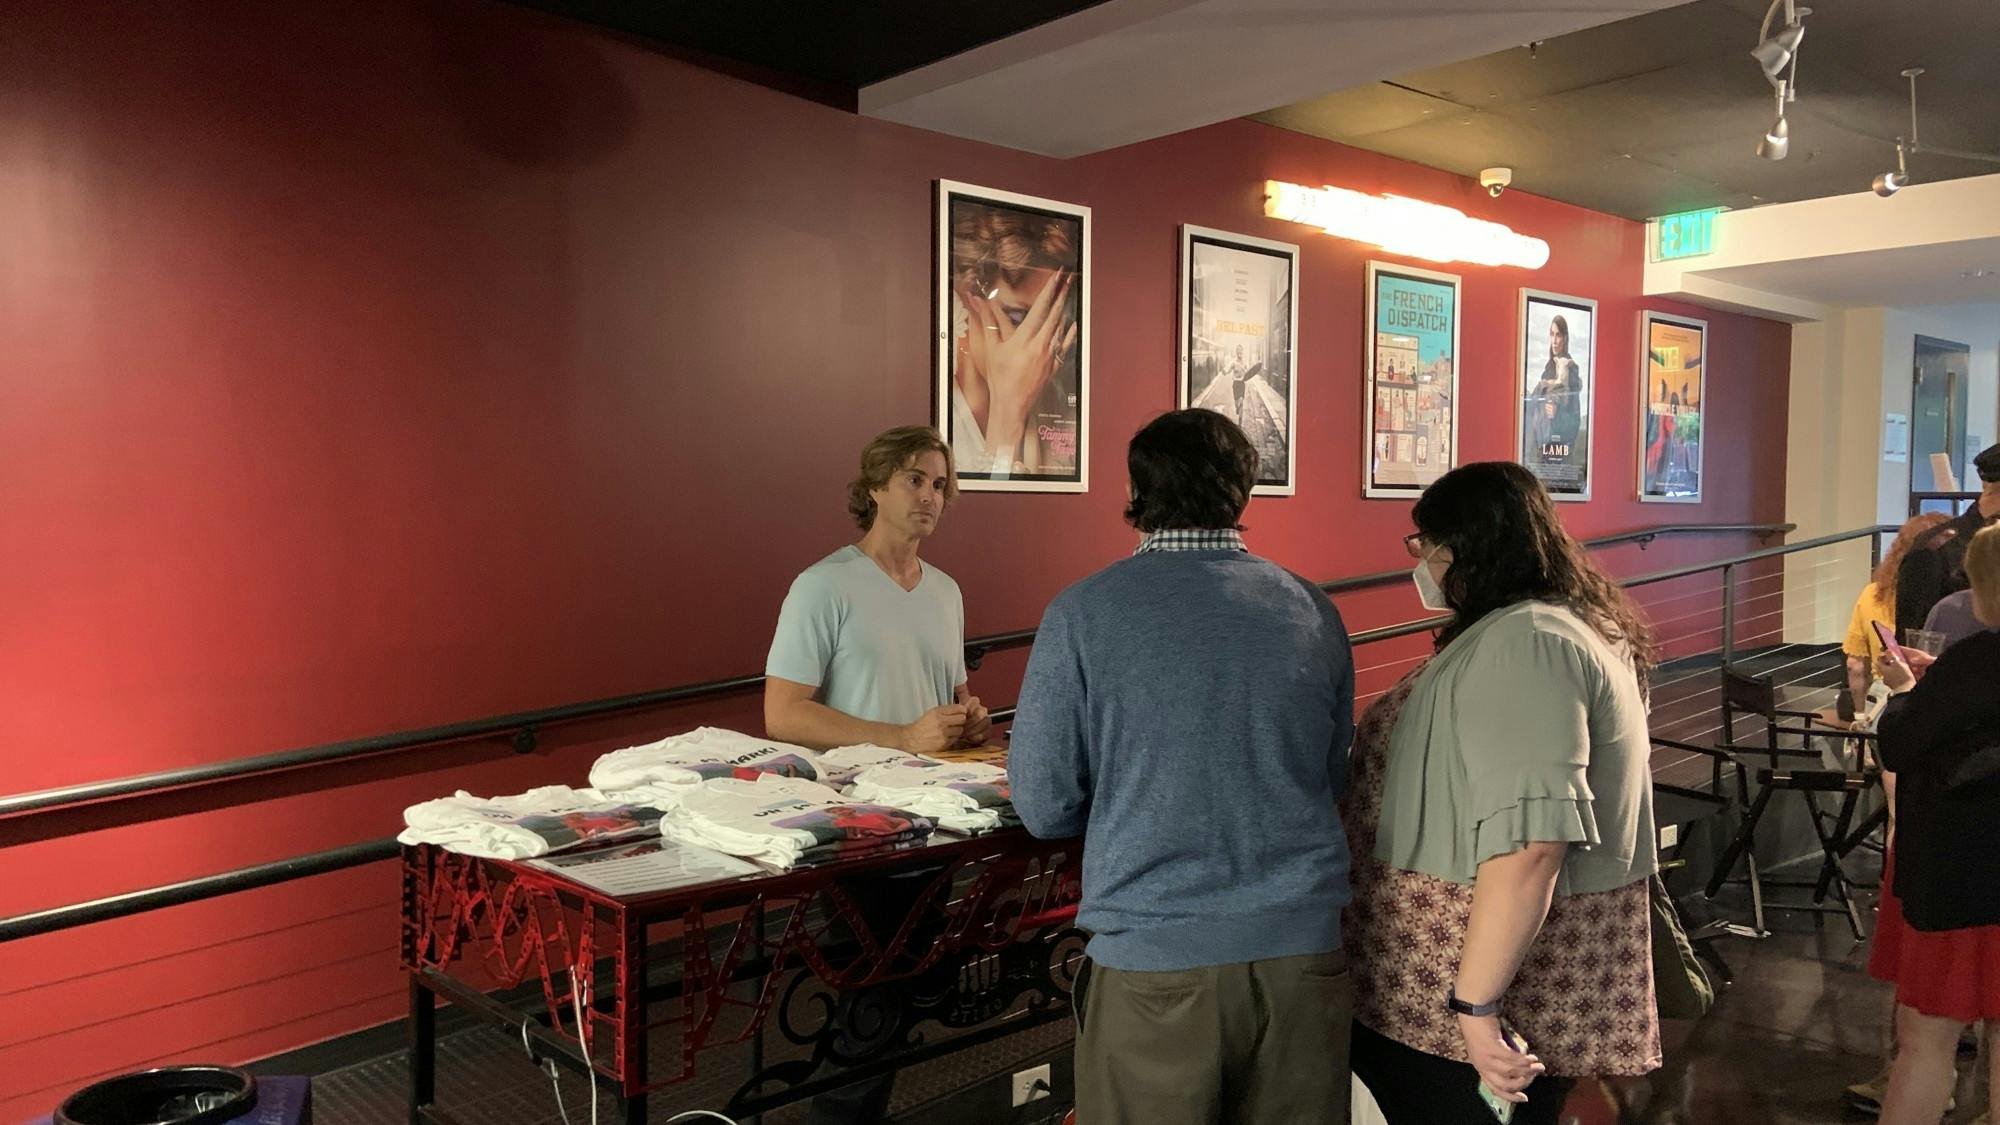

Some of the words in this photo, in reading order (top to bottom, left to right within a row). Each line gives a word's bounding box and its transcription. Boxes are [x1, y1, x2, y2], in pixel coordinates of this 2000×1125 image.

[1664, 211, 1714, 257] EXIT
[1392, 289, 1443, 313] FRENCH
[1387, 308, 1447, 333] DISPATCH
[1542, 443, 1569, 456] LAMB
